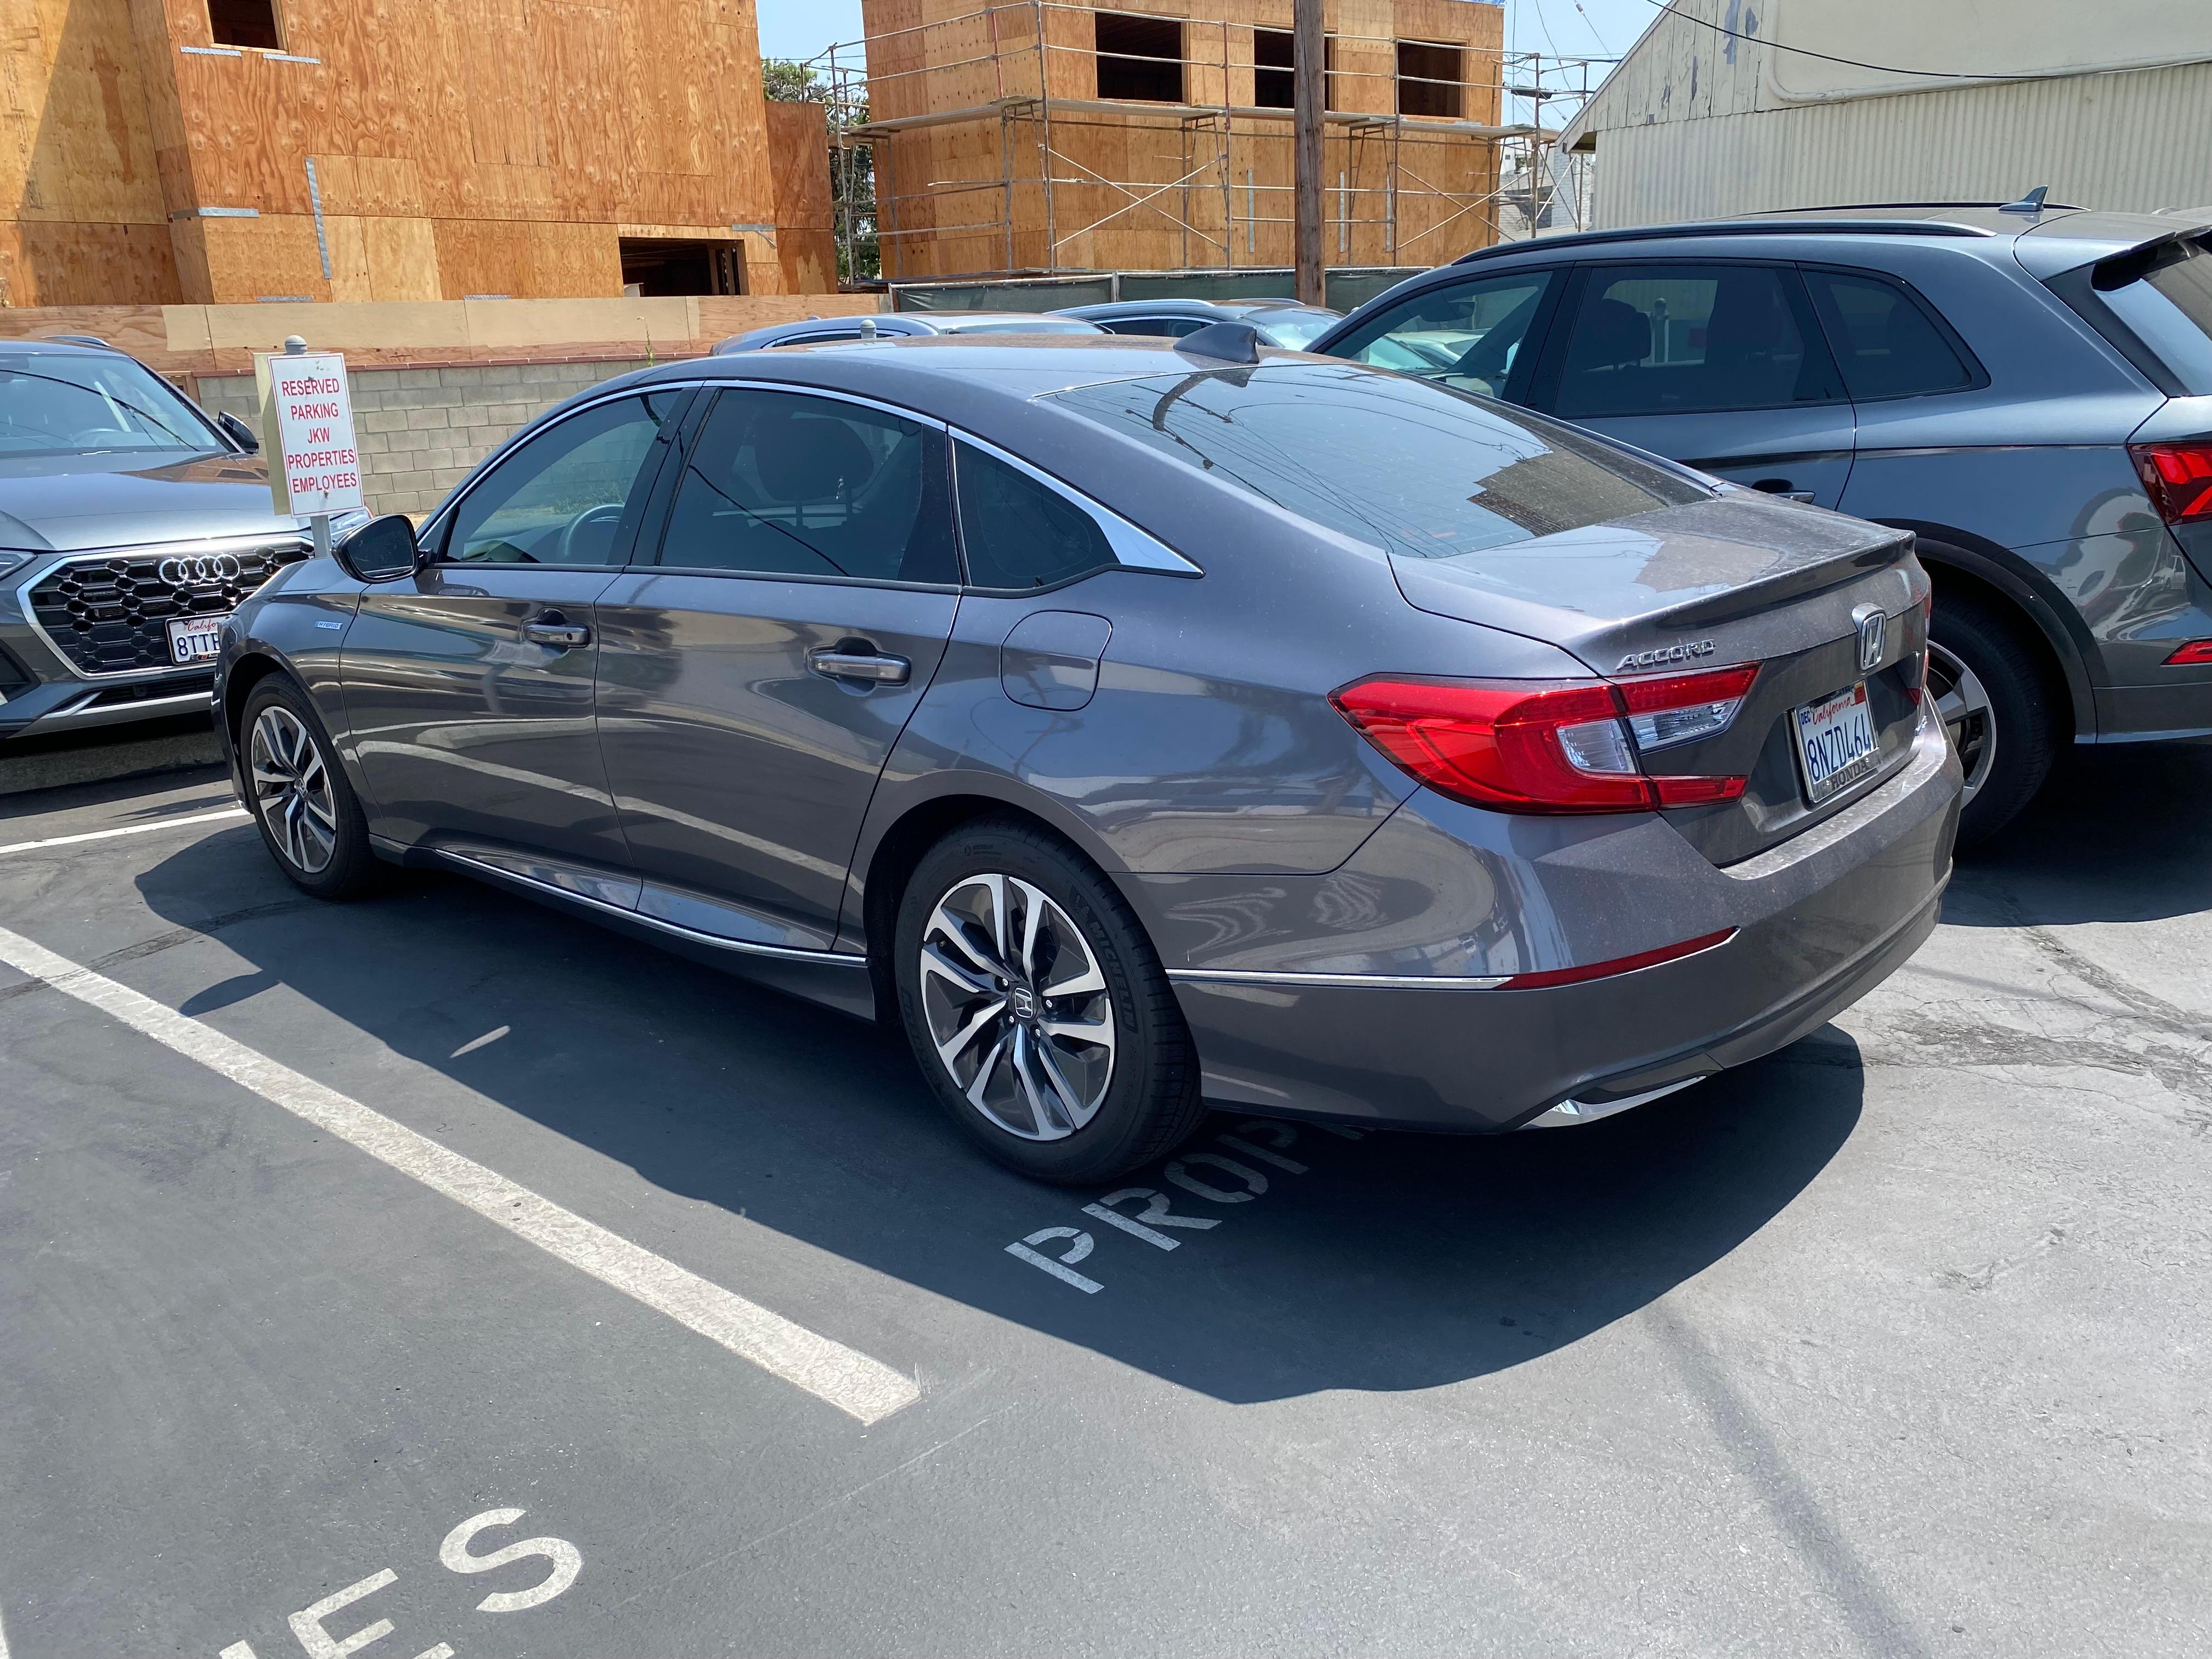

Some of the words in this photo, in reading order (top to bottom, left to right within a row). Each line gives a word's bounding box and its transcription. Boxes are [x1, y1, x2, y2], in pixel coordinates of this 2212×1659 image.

[281, 378, 339, 396] RESERVED
[291, 402, 338, 420] PARKING
[307, 427, 329, 444] JKW
[287, 449, 355, 470] PROPERTIES
[292, 472, 357, 493] EMPLOYEES
[188, 619, 219, 631] Califo
[1616, 639, 1716, 670] ACCORD
[1801, 710, 1811, 725] DEC
[1813, 696, 1855, 725] California
[1807, 714, 1872, 781] 8NZD464
[1831, 758, 1868, 790] HONDA
[1004, 1120, 1364, 1294] PROP
[219, 1508, 583, 1659] ES
